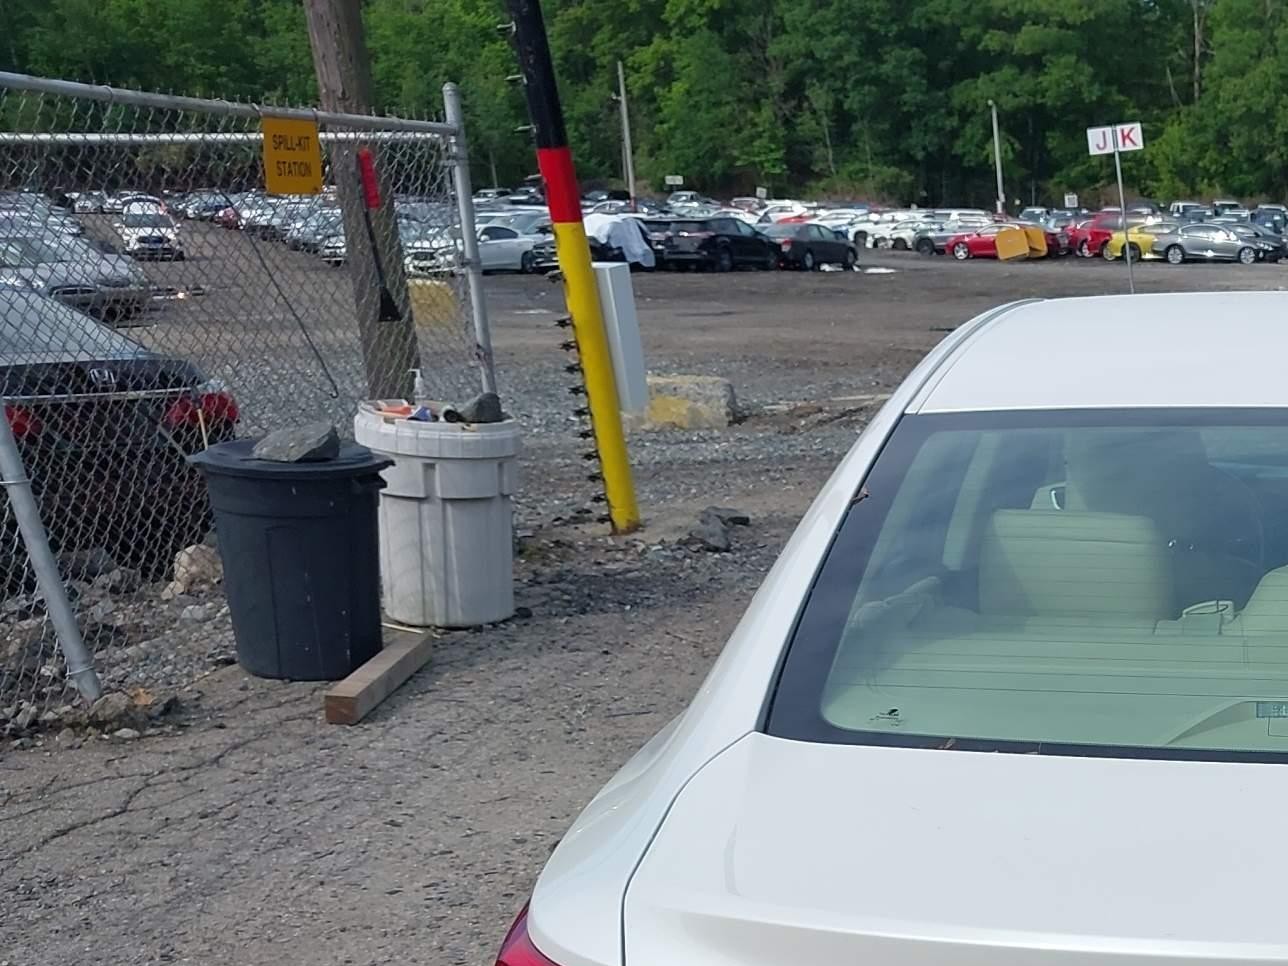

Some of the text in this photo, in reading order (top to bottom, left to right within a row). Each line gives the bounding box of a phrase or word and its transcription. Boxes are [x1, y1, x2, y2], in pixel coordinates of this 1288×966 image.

[272, 133, 311, 152] SPILL-KIT
[1095, 127, 1137, 151] J K
[276, 160, 313, 177] STATION
